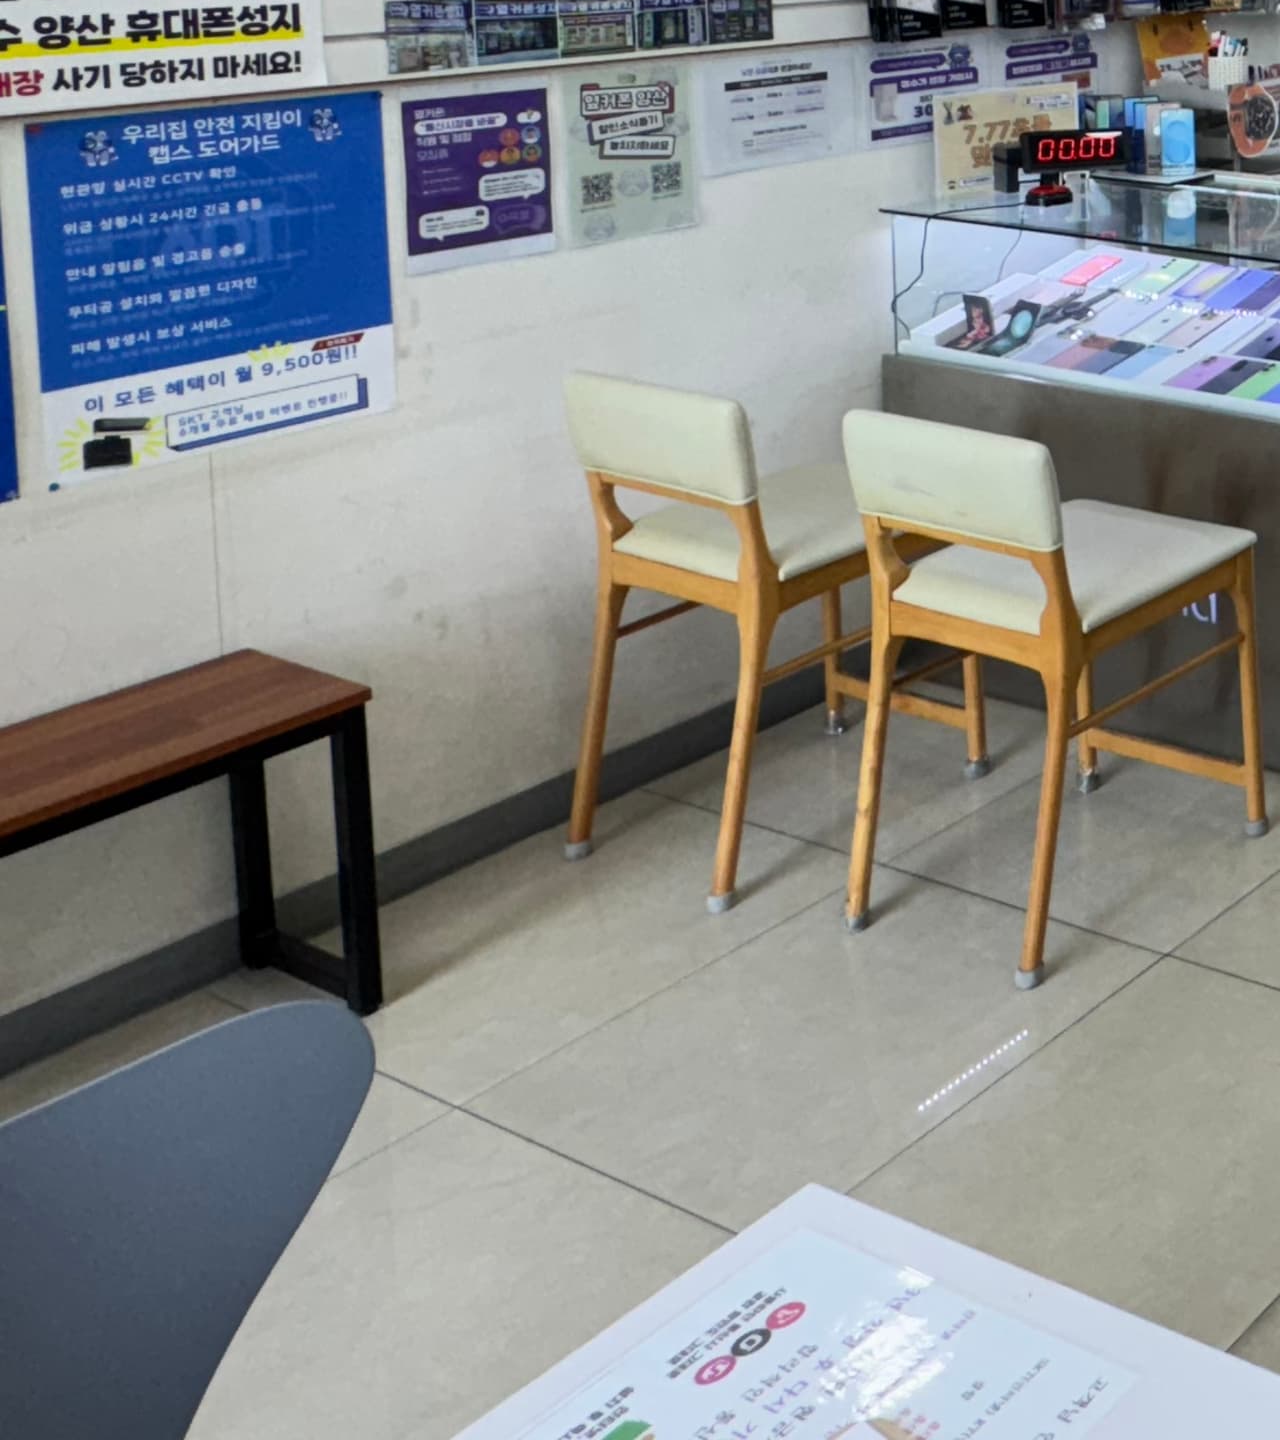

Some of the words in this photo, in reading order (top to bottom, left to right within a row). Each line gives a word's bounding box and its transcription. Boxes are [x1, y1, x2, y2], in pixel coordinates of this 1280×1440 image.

[33, 13, 115, 50] 양산
[126, 3, 301, 42] 휴대폰성지
[52, 64, 111, 92] 사기
[120, 58, 205, 88] 당하지
[214, 50, 301, 78] 마세요!
[121, 118, 187, 144] 우리집
[194, 116, 236, 139] 안전
[242, 109, 302, 133] 지킴이
[199, 133, 281, 159] 도어가드
[113, 176, 156, 192] 실시간
[161, 171, 204, 185] CCTV
[148, 208, 198, 224] 24시간
[216, 276, 258, 292] 디자인
[190, 317, 233, 333] 서비스
[84, 395, 103, 413] 이
[115, 386, 157, 406] 모든
[165, 371, 226, 396] 혜택이
[235, 365, 253, 383] 월
